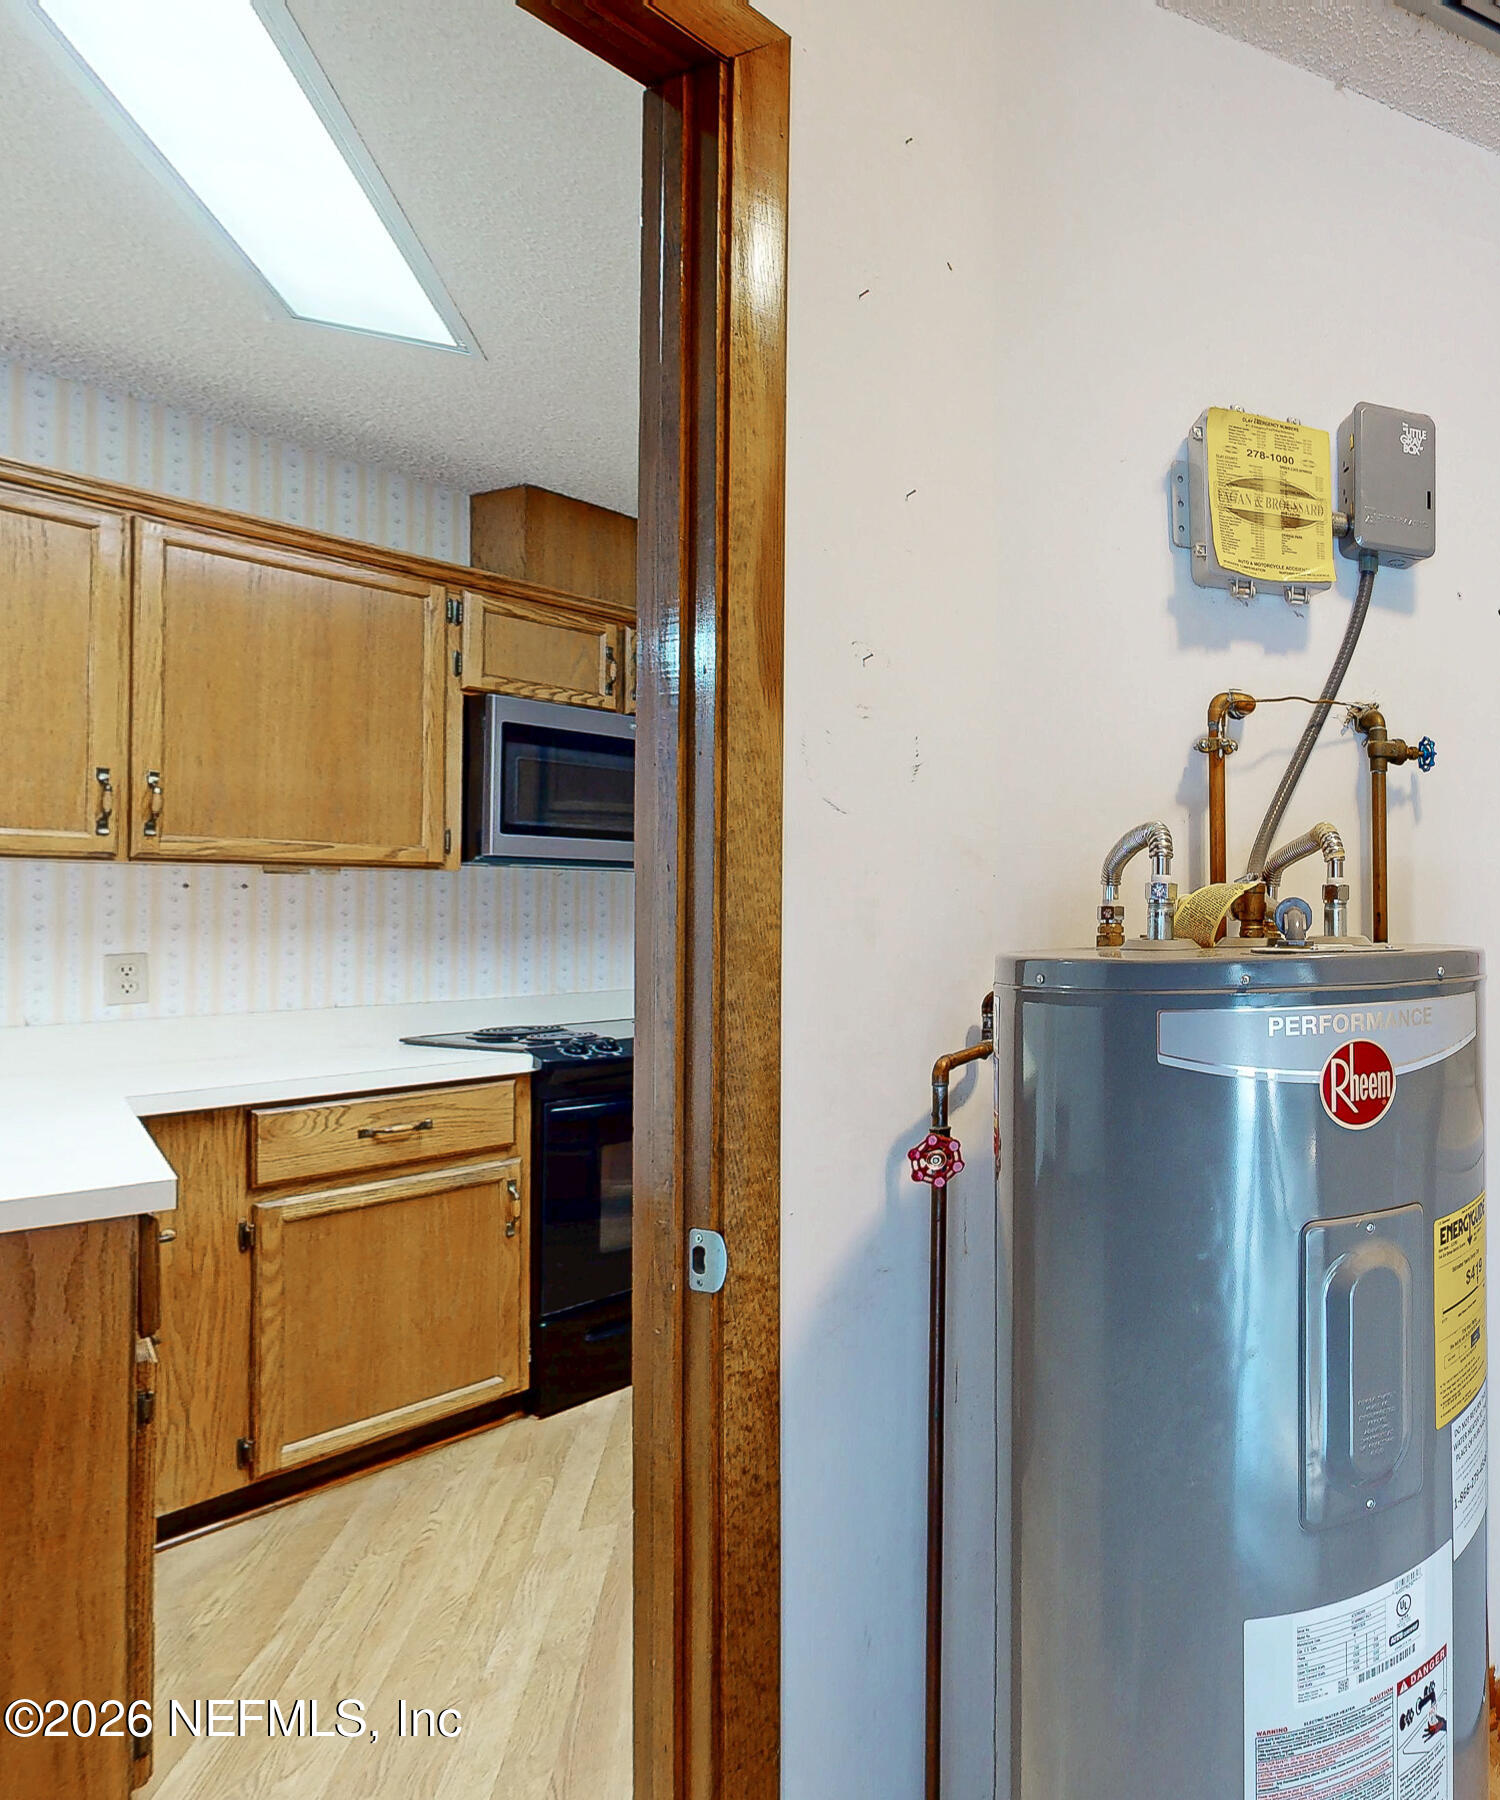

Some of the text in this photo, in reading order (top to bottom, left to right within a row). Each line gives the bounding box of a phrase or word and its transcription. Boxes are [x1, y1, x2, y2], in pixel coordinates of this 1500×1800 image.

[1246, 448, 1295, 465] 278-1000
[1267, 1006, 1433, 1038] PERFORMANCE
[1331, 1042, 1391, 1114] Rheem
[1410, 1649, 1446, 1685] DANGER
[1369, 1687, 1393, 1703] CAUTION
[1256, 1726, 1288, 1736] WARNING
